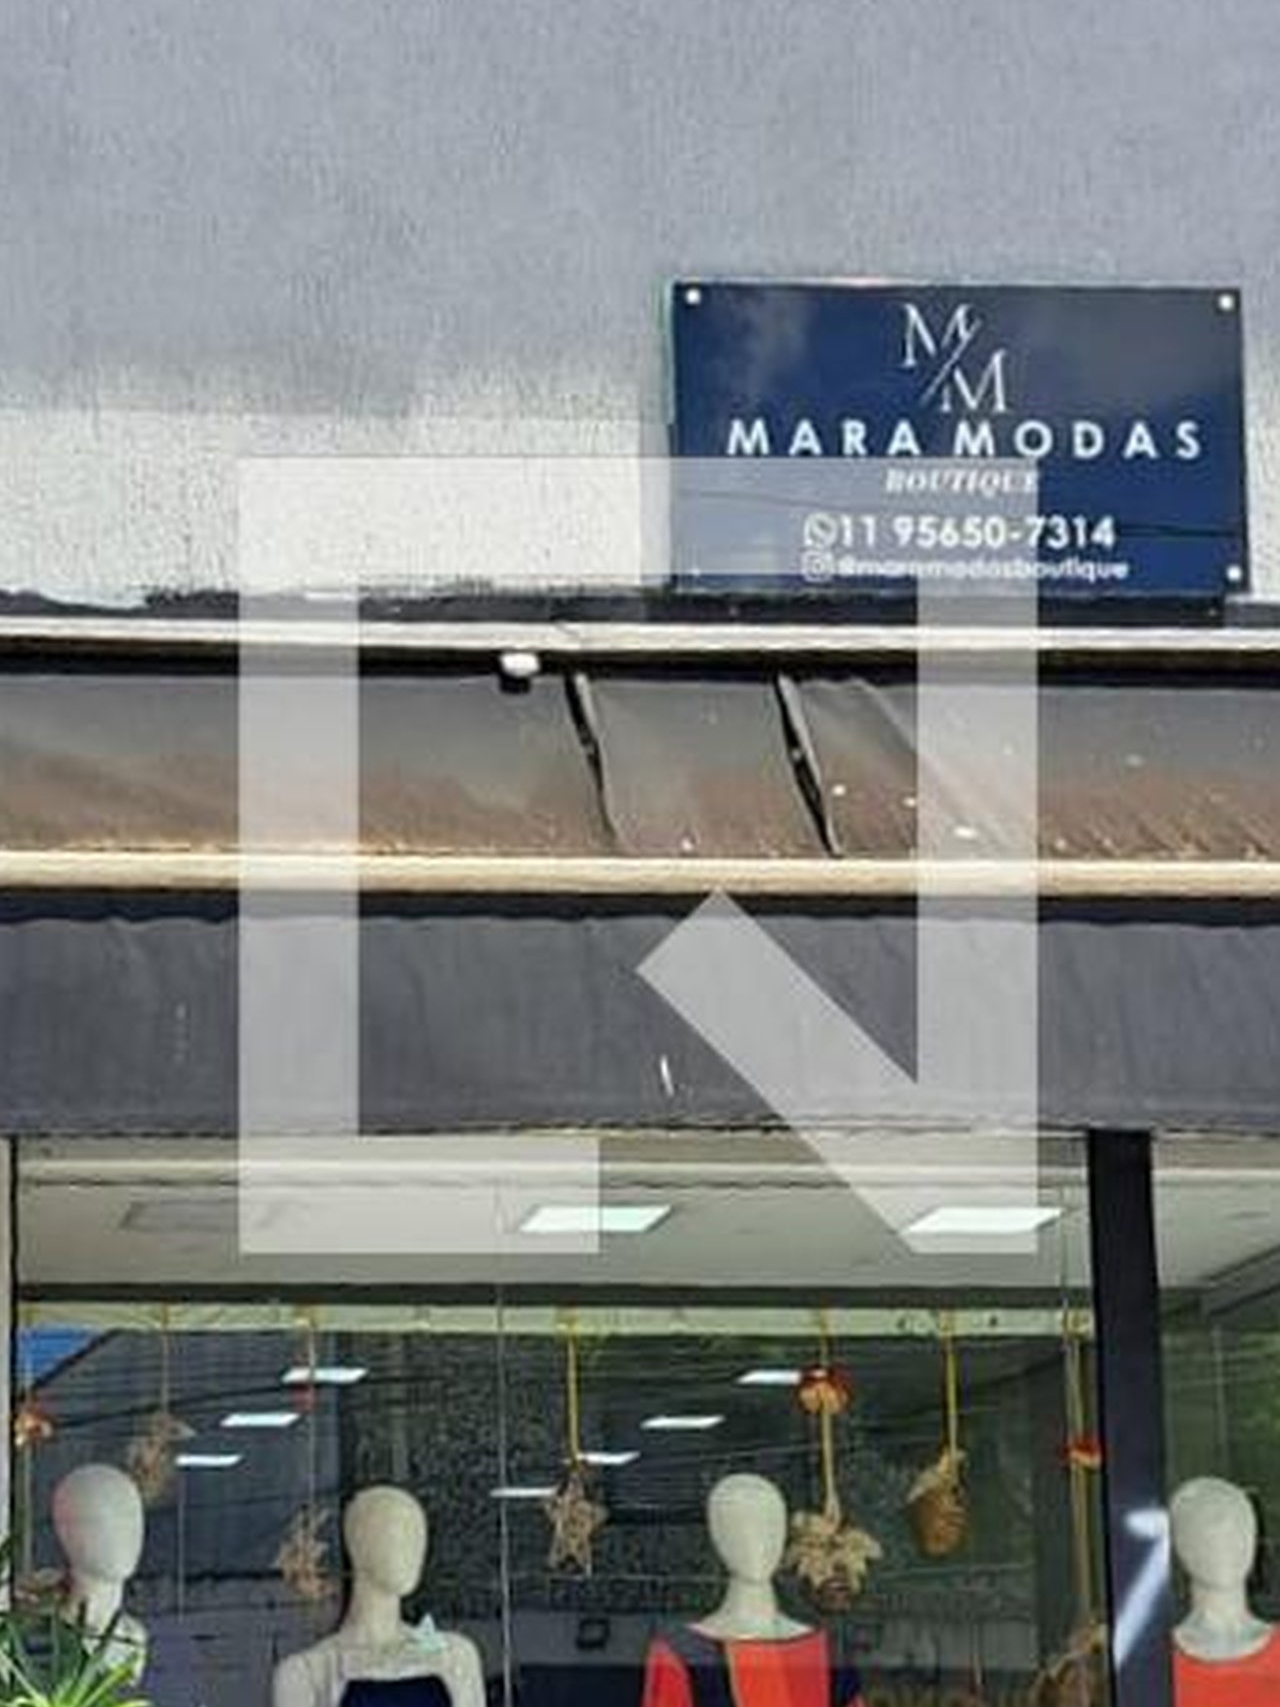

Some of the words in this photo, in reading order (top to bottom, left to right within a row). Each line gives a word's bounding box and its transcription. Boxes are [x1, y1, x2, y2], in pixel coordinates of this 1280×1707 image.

[727, 418, 922, 456] MARA
[952, 419, 1202, 460] MODAS
[892, 514, 1117, 549] 95650-7314
